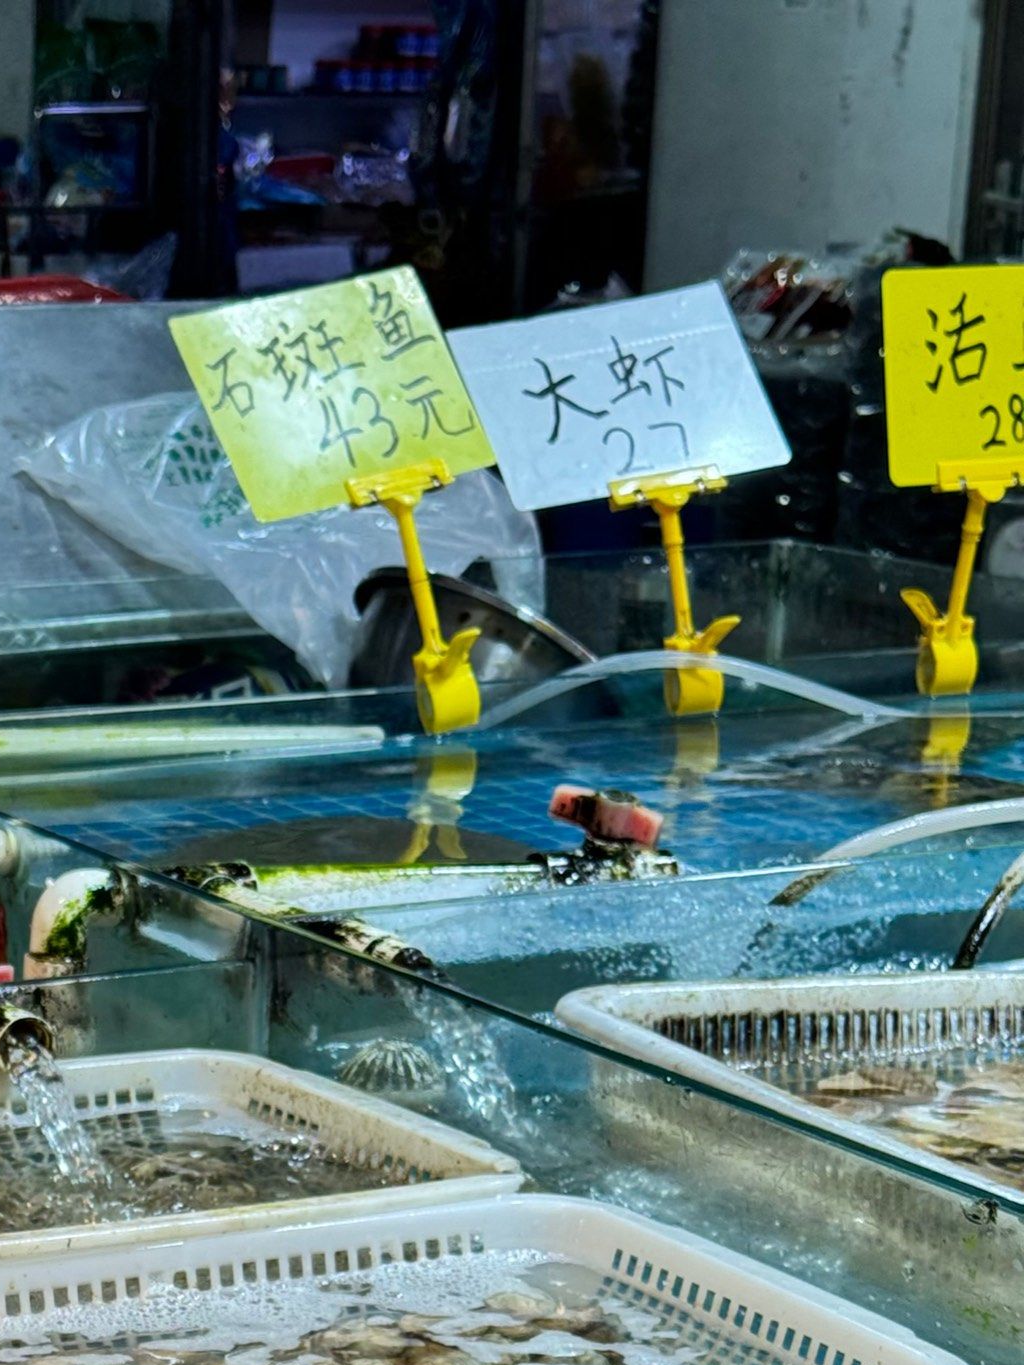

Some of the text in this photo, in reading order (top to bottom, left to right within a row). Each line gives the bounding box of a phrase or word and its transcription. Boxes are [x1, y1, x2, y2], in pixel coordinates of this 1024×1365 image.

[210, 282, 436, 418] 石斑鱼
[522, 336, 686, 445] 大虾
[925, 292, 1024, 394] 活
[320, 376, 475, 468] 43元
[602, 422, 691, 476] 27
